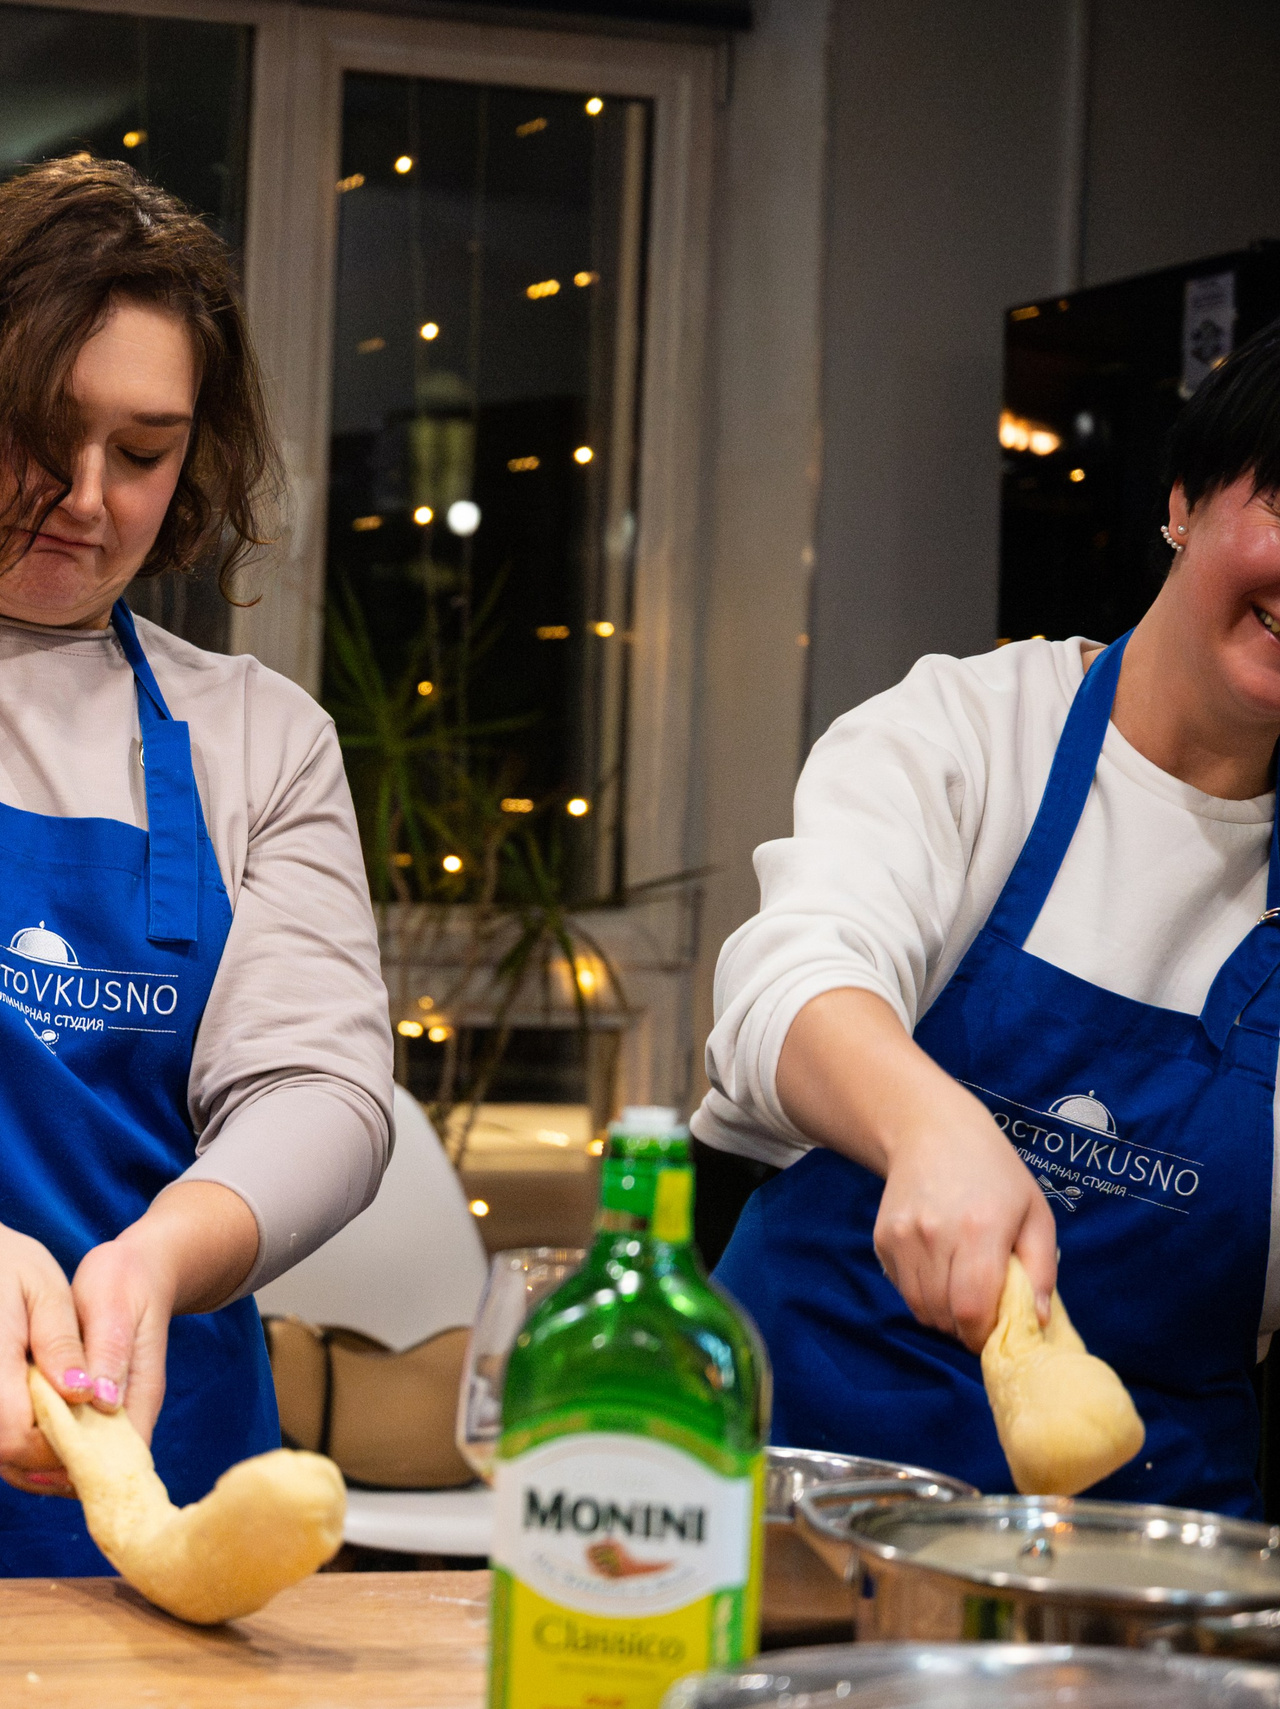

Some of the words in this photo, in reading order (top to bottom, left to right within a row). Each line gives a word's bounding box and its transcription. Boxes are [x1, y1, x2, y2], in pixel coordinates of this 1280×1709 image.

[54, 1014, 105, 1032] СТУДИЯ
[992, 1112, 1199, 1197] остоVKUSNO
[1011, 1144, 1080, 1182] УЛИНАРНАЯ
[1082, 1175, 1127, 1197] СТУДИЯ
[523, 1485, 707, 1543] MONINI
